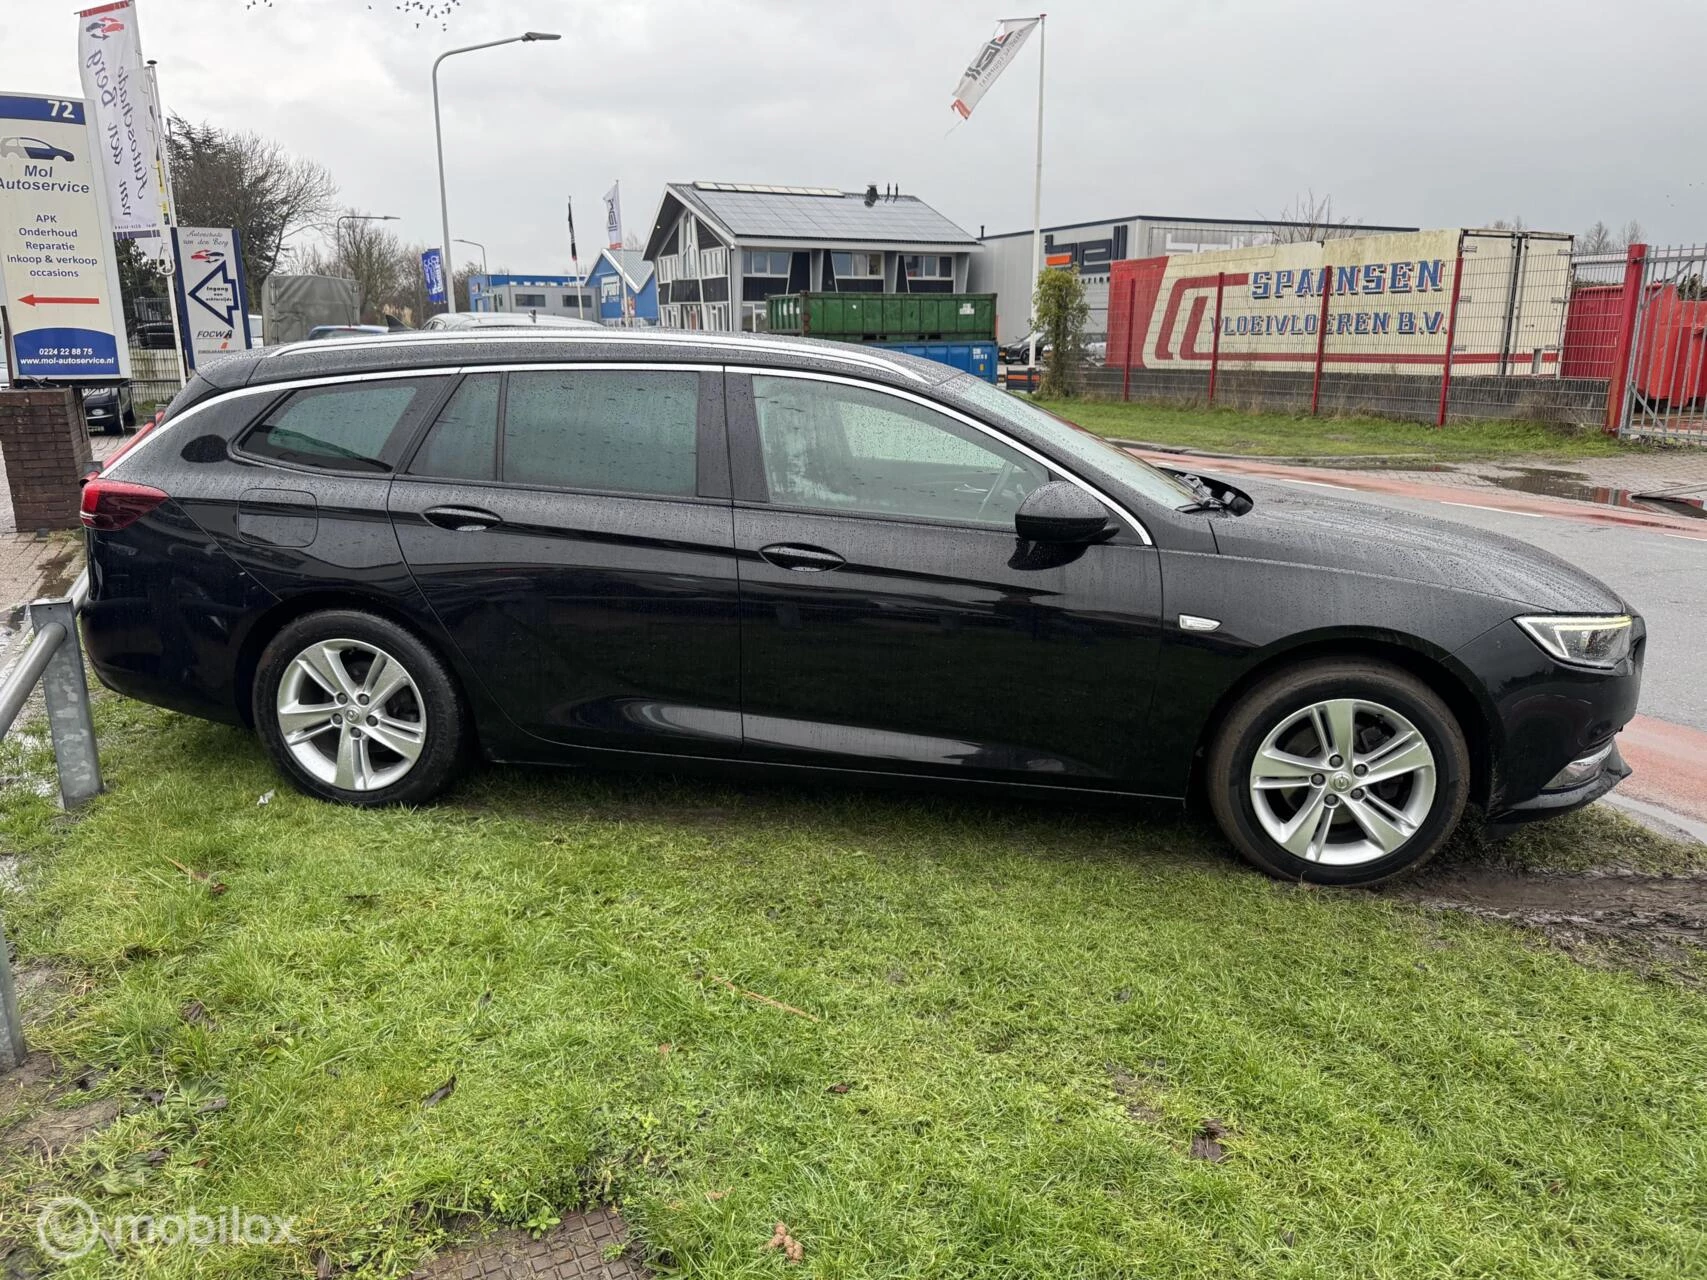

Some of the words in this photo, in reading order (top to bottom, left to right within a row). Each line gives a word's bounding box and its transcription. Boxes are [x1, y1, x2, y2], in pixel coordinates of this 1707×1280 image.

[48, 100, 75, 119] 72
[24, 165, 53, 178] Mol
[36, 214, 57, 223] APK
[18, 227, 78, 238] Onderhoud
[25, 241, 76, 252] Reparatie
[6, 254, 42, 264] Inkoop
[44, 255, 53, 263] &
[55, 256, 98, 266] verkoop
[29, 268, 80, 277] occasions
[1251, 259, 1446, 299] SPAANSEN
[1397, 311, 1448, 335] B.V.
[20, 356, 114, 365] www.mol-autoservice.nl
